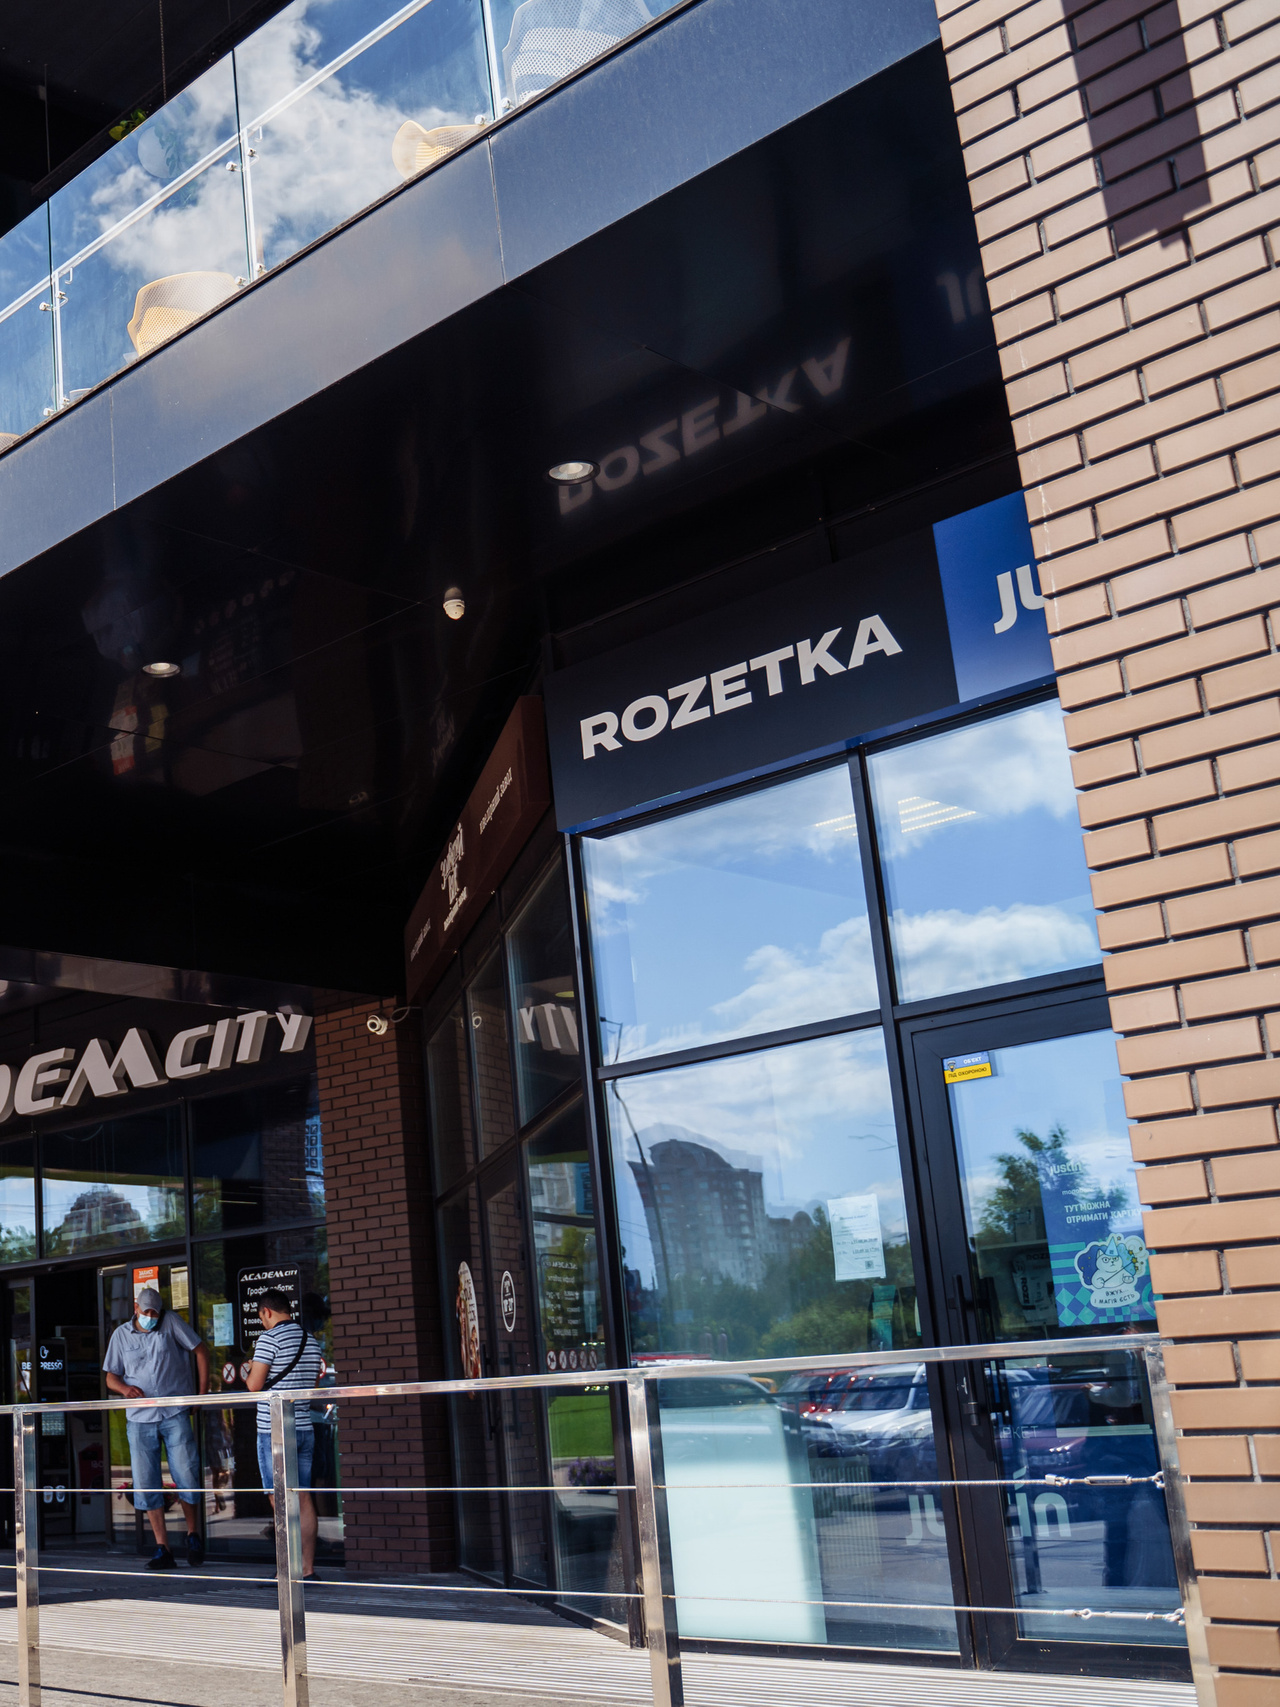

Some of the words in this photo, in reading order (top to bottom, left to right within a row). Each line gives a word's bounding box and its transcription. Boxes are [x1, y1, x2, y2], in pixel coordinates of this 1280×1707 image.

[579, 614, 903, 760] ROZETKA
[993, 564, 1048, 635] JU
[165, 1010, 313, 1079] CITY
[1050, 1162, 1082, 1176] justin
[1064, 1204, 1079, 1213] ТУТ
[1080, 1201, 1111, 1212] МОЖНА
[1066, 1213, 1108, 1224] ОТРИМАТИ
[240, 1270, 284, 1282] ACADEM
